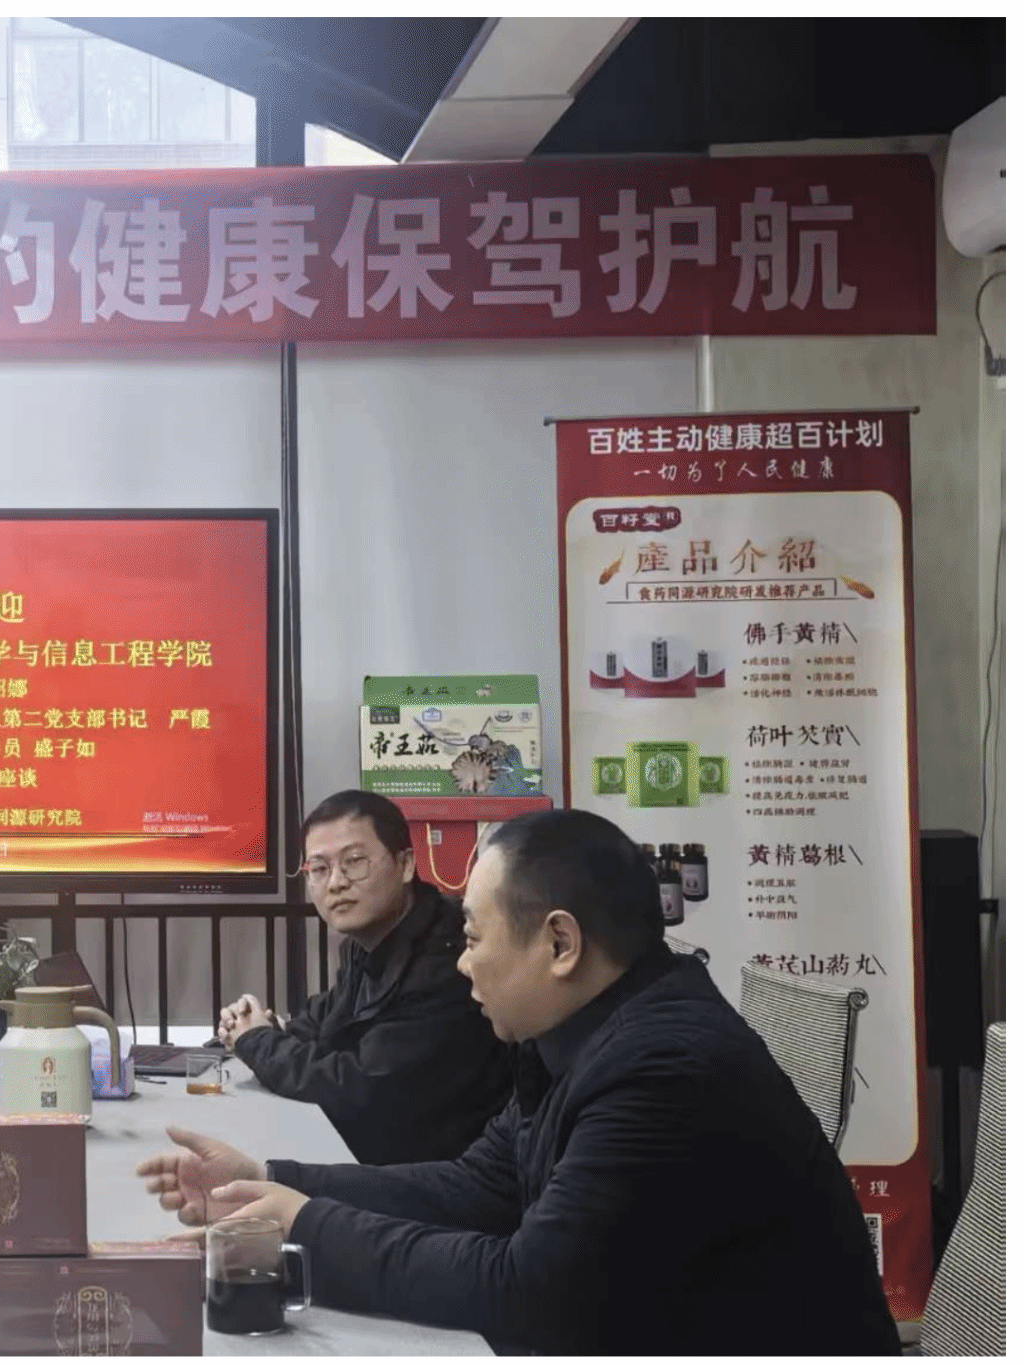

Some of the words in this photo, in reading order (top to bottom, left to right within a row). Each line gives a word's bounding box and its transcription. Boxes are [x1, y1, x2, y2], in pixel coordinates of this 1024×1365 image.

[587, 419, 884, 455] 百姓主动健康超百计划
[632, 456, 835, 482] 一切为了人民健康
[635, 537, 818, 576] 產品介紹
[638, 583, 825, 601] 食药同源研究院研发推荐产品
[169, 708, 211, 731] 严霞
[32, 736, 96, 760] 盛子如
